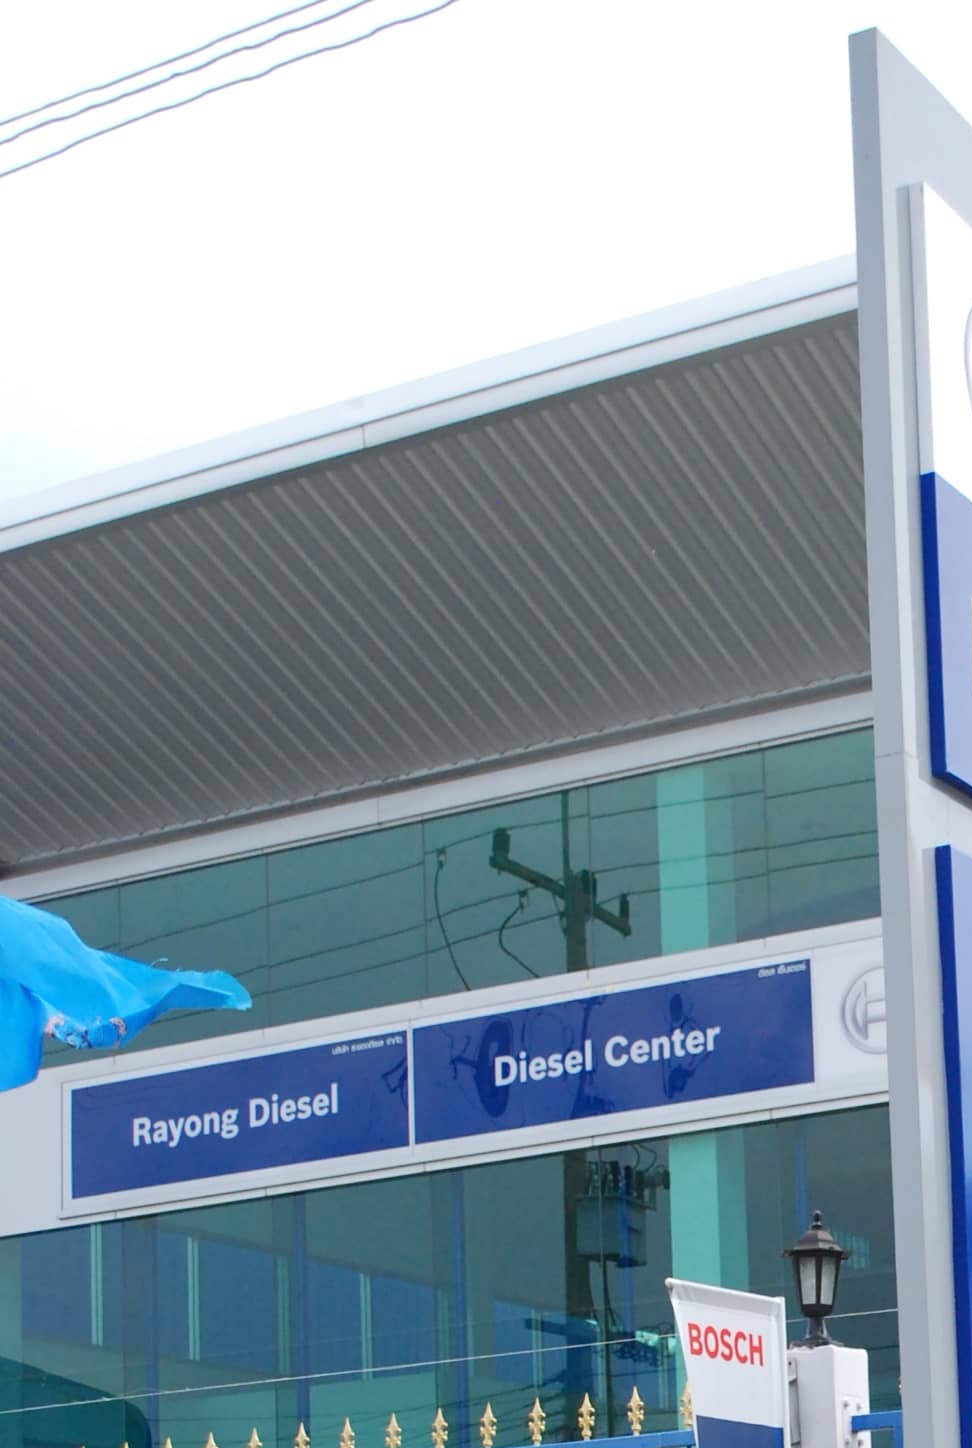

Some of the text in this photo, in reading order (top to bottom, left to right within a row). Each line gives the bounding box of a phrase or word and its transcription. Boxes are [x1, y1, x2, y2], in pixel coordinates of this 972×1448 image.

[494, 1026, 721, 1087] Diesel Center
[132, 1082, 338, 1148] Rayong Diesel
[688, 1322, 764, 1367] BOSCH
